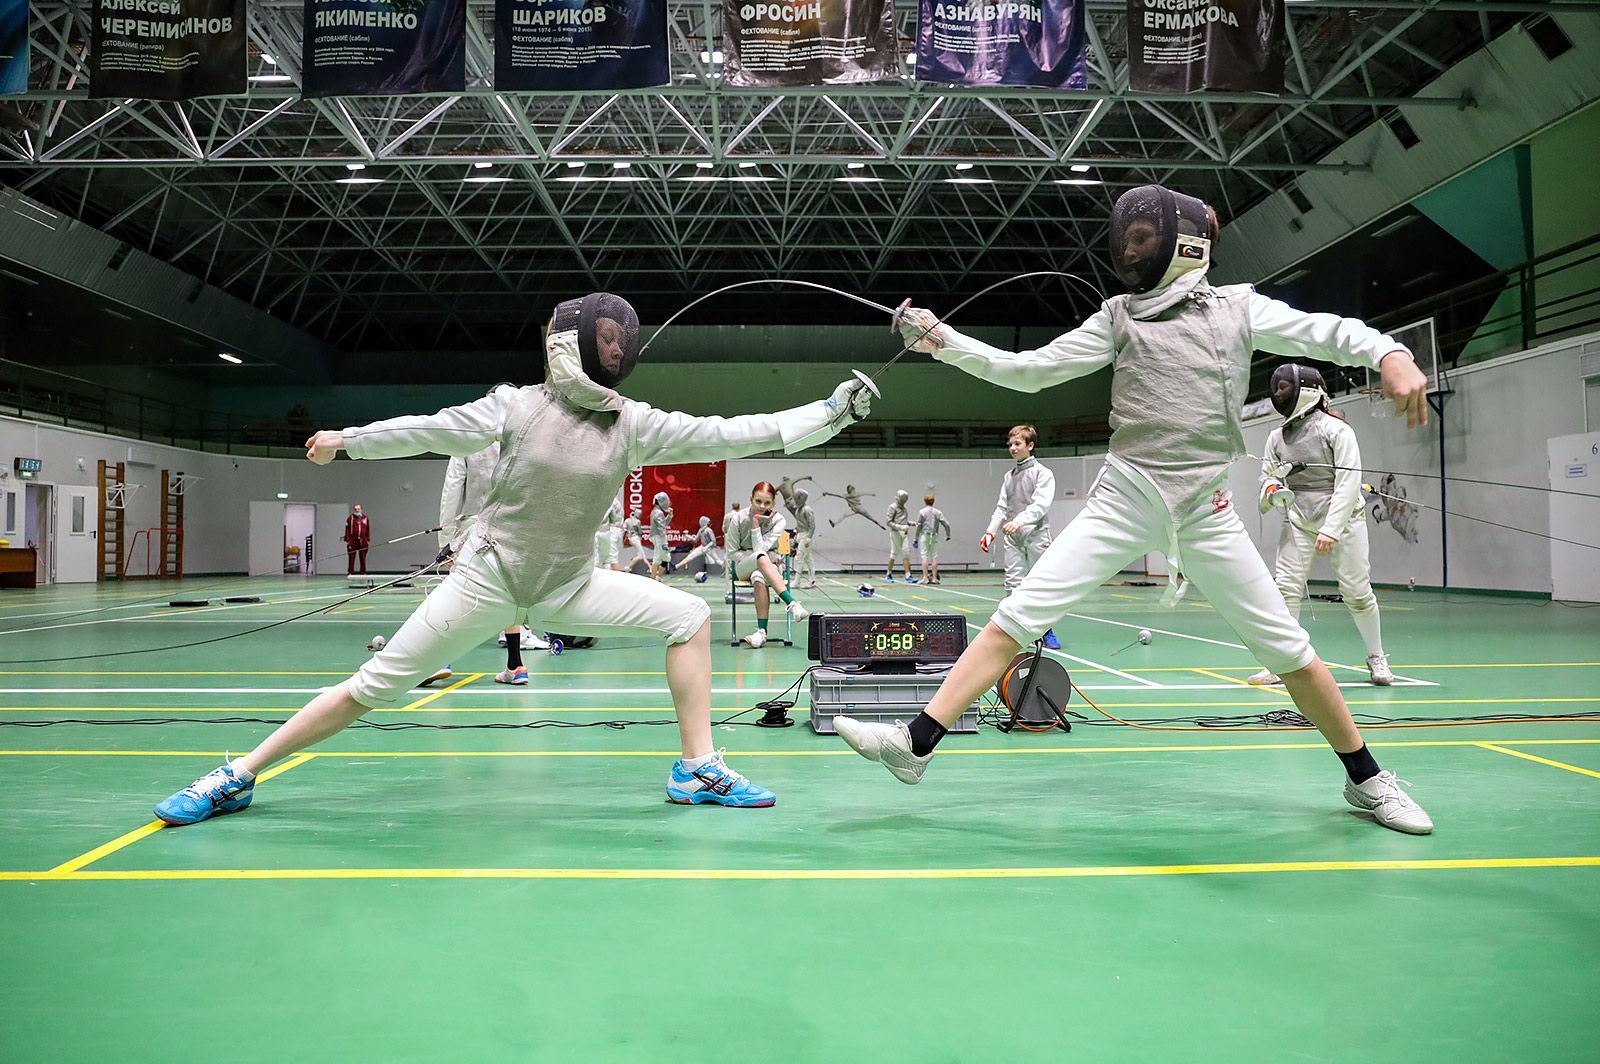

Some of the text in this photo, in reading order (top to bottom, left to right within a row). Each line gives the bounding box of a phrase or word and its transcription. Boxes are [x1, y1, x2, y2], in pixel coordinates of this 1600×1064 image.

[315, 9, 418, 30] ЯКИМЕНКО
[512, 6, 607, 25] ШАРИКОВ
[740, 3, 821, 22] ФРОСИН
[934, 3, 1042, 23] АЗНАВУРЯН
[1143, 6, 1239, 29] ЕРМАКОВА
[101, 17, 233, 39] ЧЕРЕМИСИНОВ
[741, 27, 780, 35] ФЕХТОВАНИЕ
[512, 35, 552, 43] ФЕХТОВАНИЕ
[876, 633, 914, 650] 0:58
